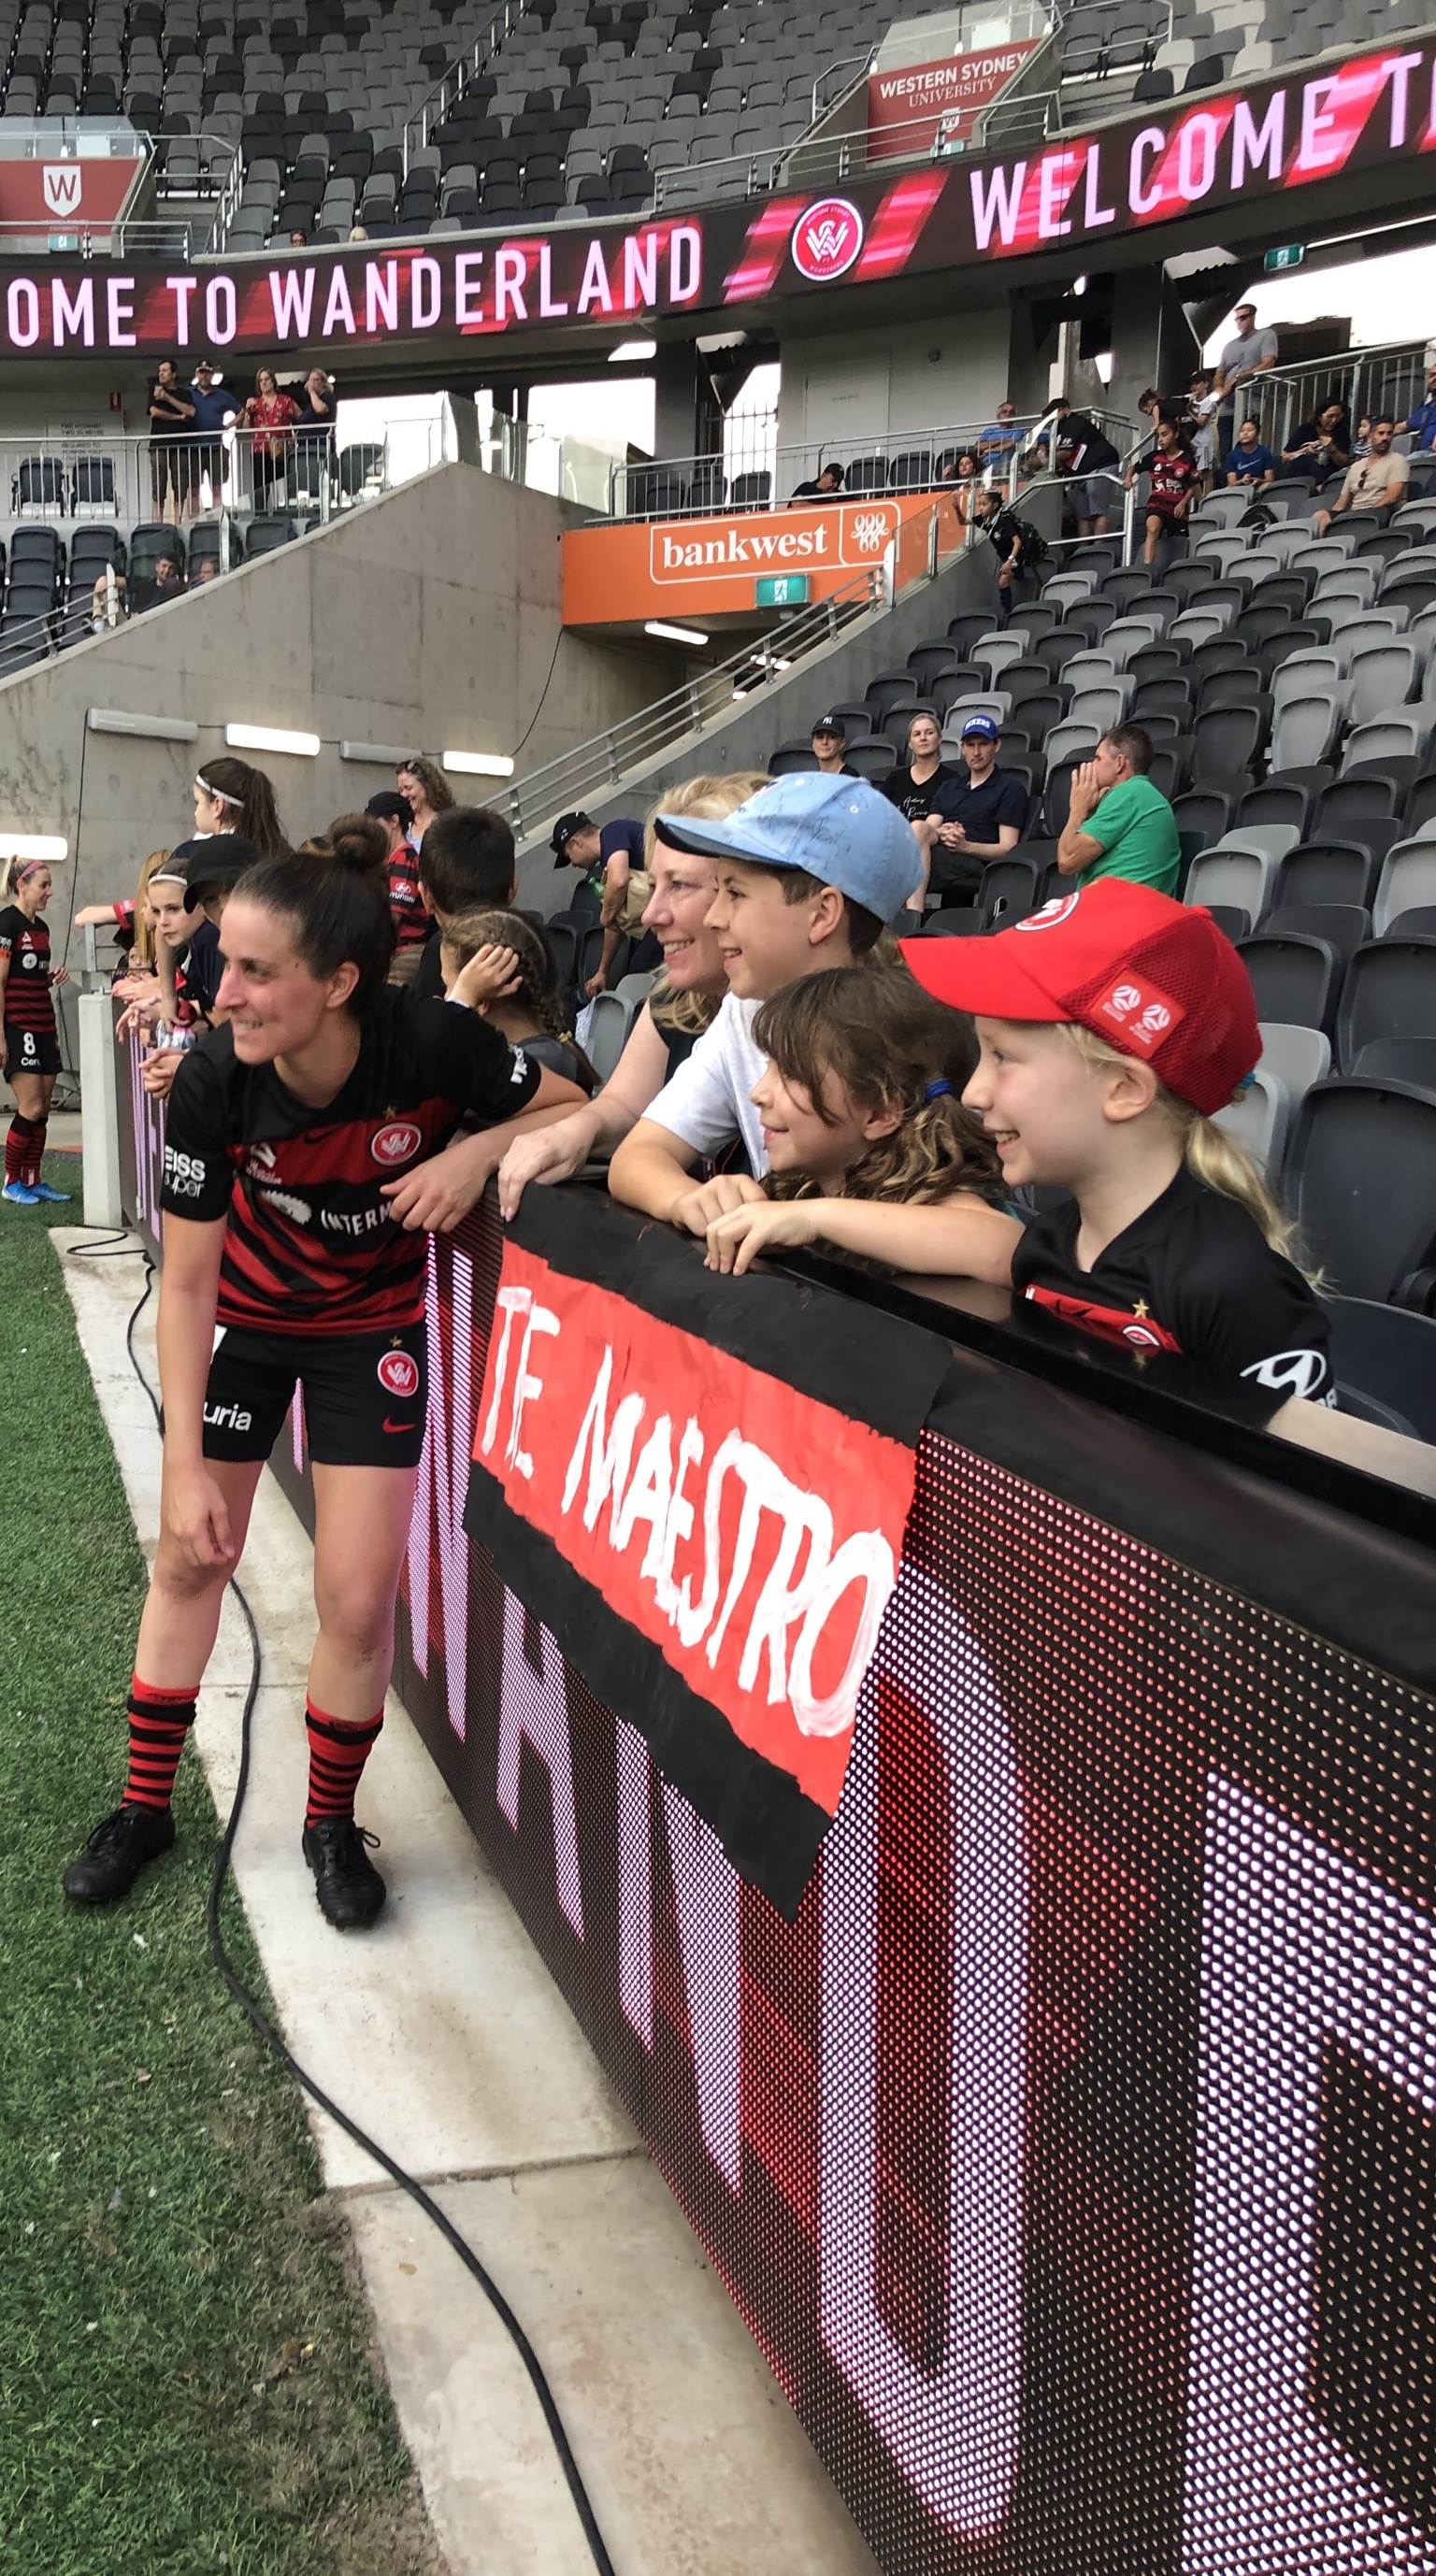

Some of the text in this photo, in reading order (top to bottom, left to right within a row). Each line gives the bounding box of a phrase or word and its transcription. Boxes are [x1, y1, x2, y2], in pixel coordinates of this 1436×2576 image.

[880, 50, 1028, 99] WESTERN SYDNEY
[908, 76, 997, 108] UNIVERSITY
[969, 75, 1343, 250] WELCOME
[49, 174, 77, 202] W
[166, 275, 237, 346] TO
[268, 225, 701, 340] WANDERLAND
[662, 522, 828, 569] bankwest
[23, 1031, 36, 1056] 8
[479, 1285, 899, 1738] TE MAESTRO
